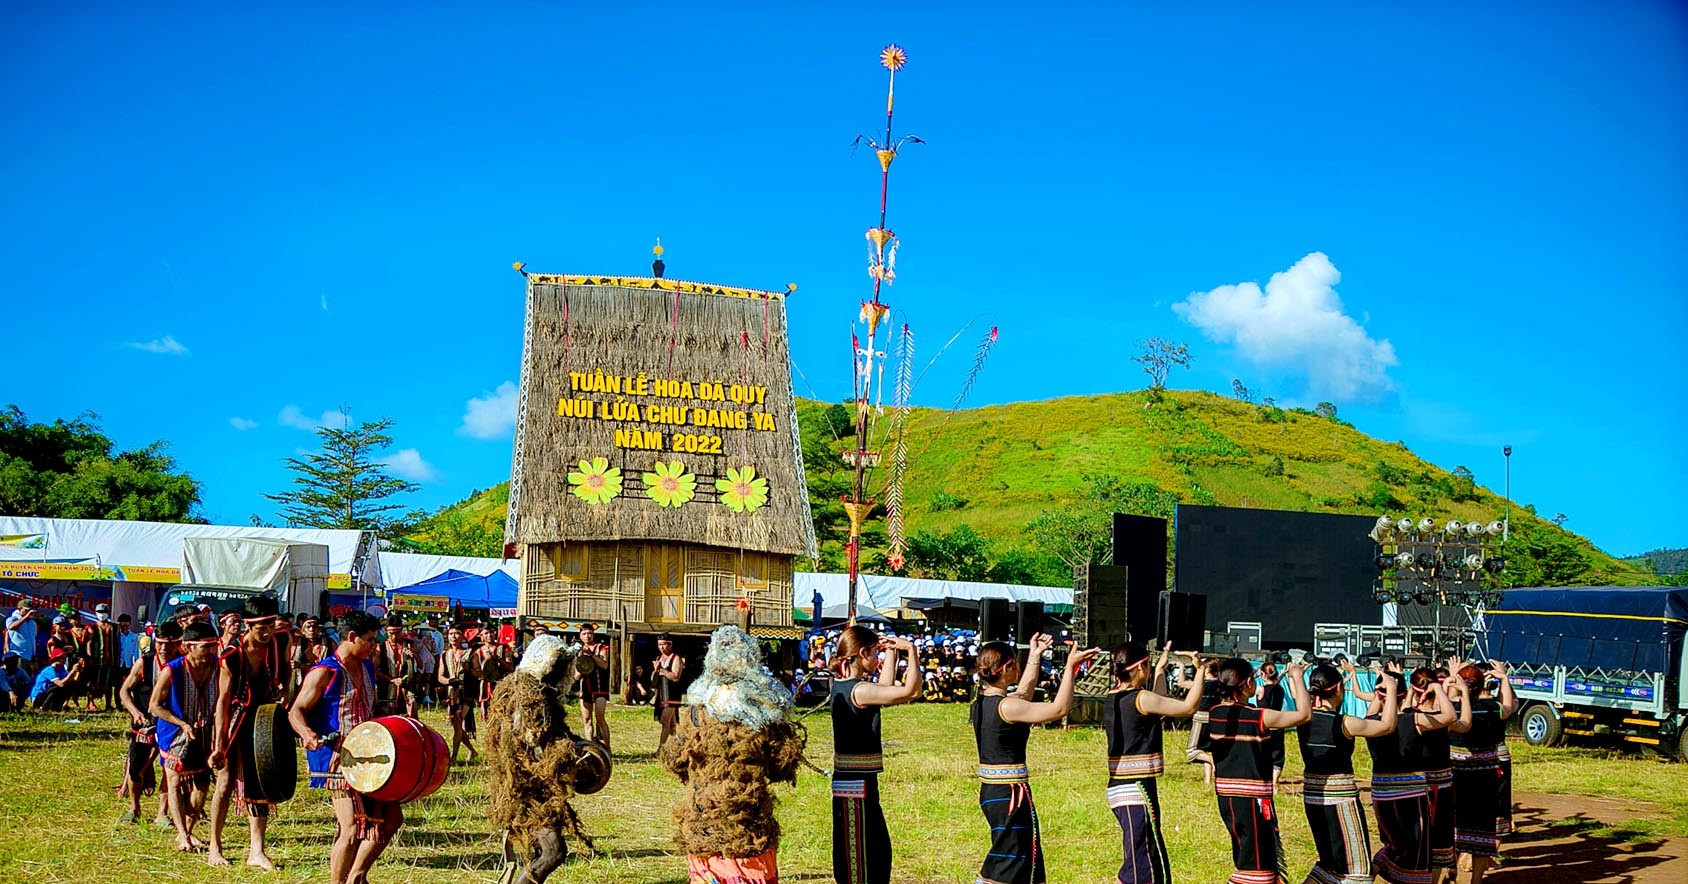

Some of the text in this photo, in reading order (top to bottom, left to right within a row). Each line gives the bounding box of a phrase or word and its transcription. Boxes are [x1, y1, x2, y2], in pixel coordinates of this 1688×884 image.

[569, 368, 767, 405] TUẦN LỄ HOA DÃ QUỲ
[558, 396, 777, 432] NÚI LỬA CHƯ ĐANG YA
[615, 428, 723, 455] NĂM 2022
